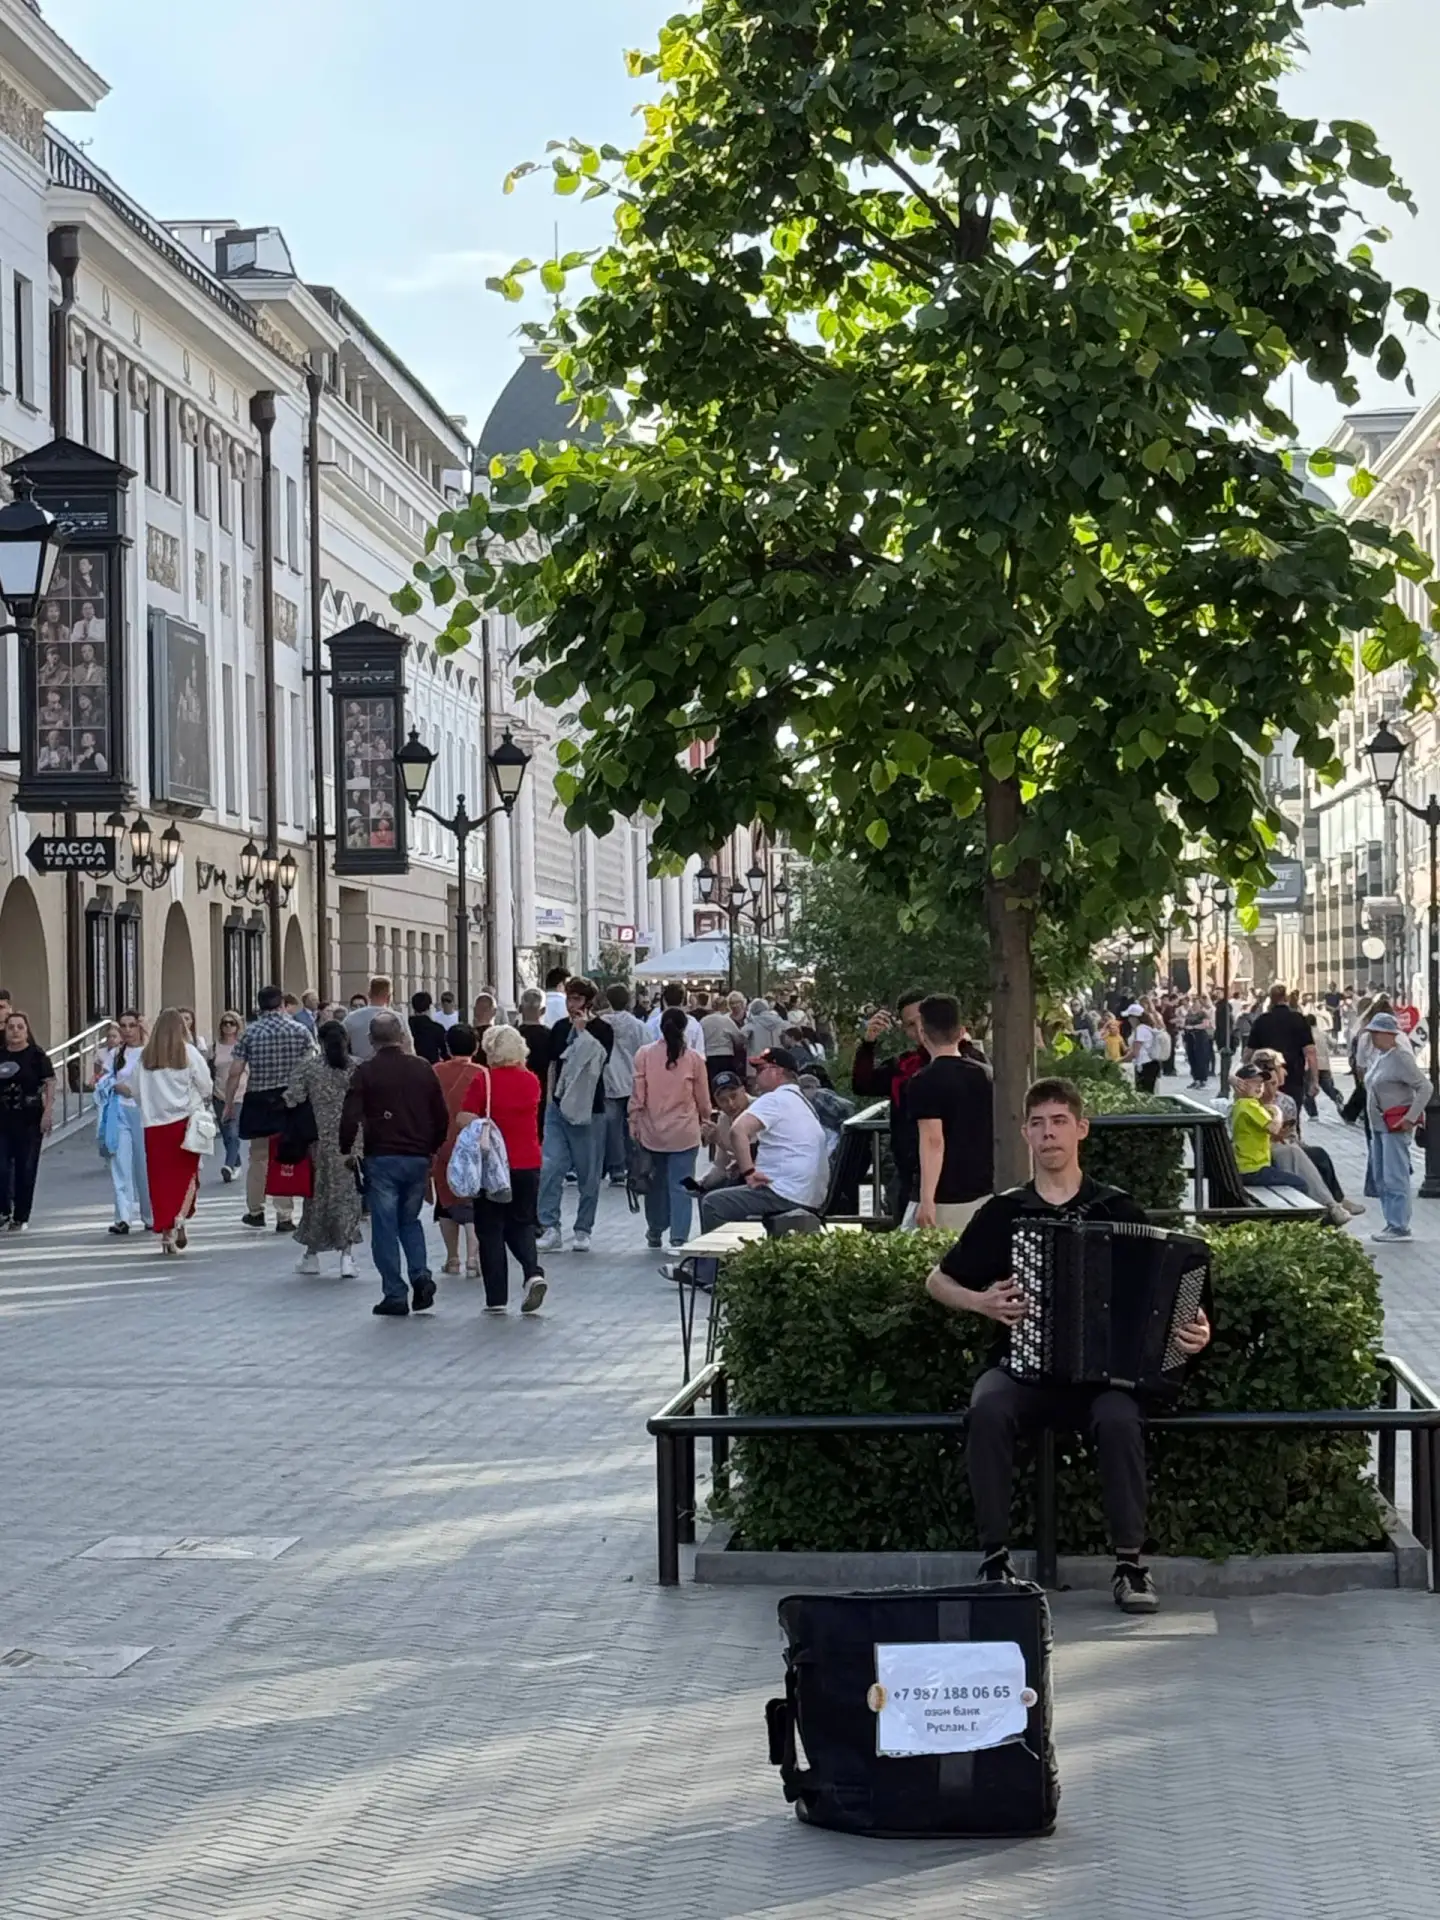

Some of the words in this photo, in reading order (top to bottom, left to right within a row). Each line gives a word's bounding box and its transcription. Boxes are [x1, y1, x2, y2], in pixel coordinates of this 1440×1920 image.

[43, 842, 106, 855] КАССА
[44, 856, 106, 866] ТЕАТРА
[894, 1688, 910, 1701] +7
[913, 1687, 939, 1700] 987
[943, 1687, 969, 1700] 188
[972, 1686, 990, 1699] 06
[993, 1685, 1011, 1698] 65
[924, 1708, 951, 1717] озон
[952, 1705, 981, 1717] банк
